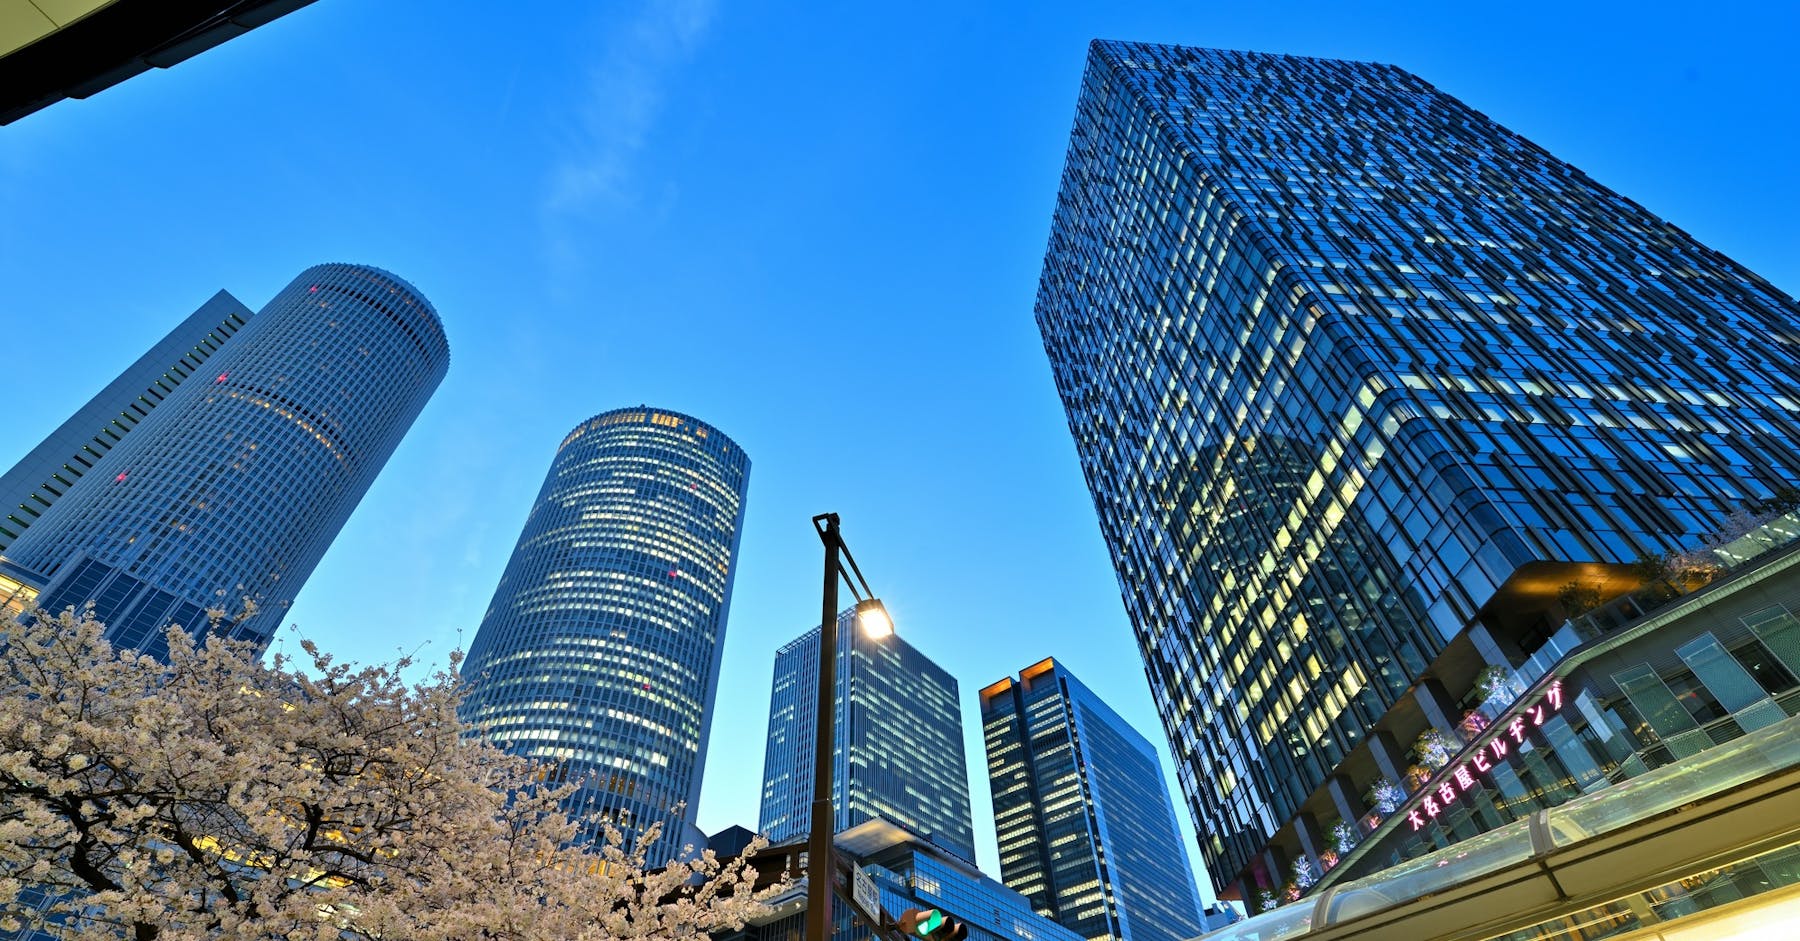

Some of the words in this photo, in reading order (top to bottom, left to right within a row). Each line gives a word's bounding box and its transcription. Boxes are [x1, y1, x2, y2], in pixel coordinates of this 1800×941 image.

[1408, 680, 1562, 831] 大名古屋ビルヂング
